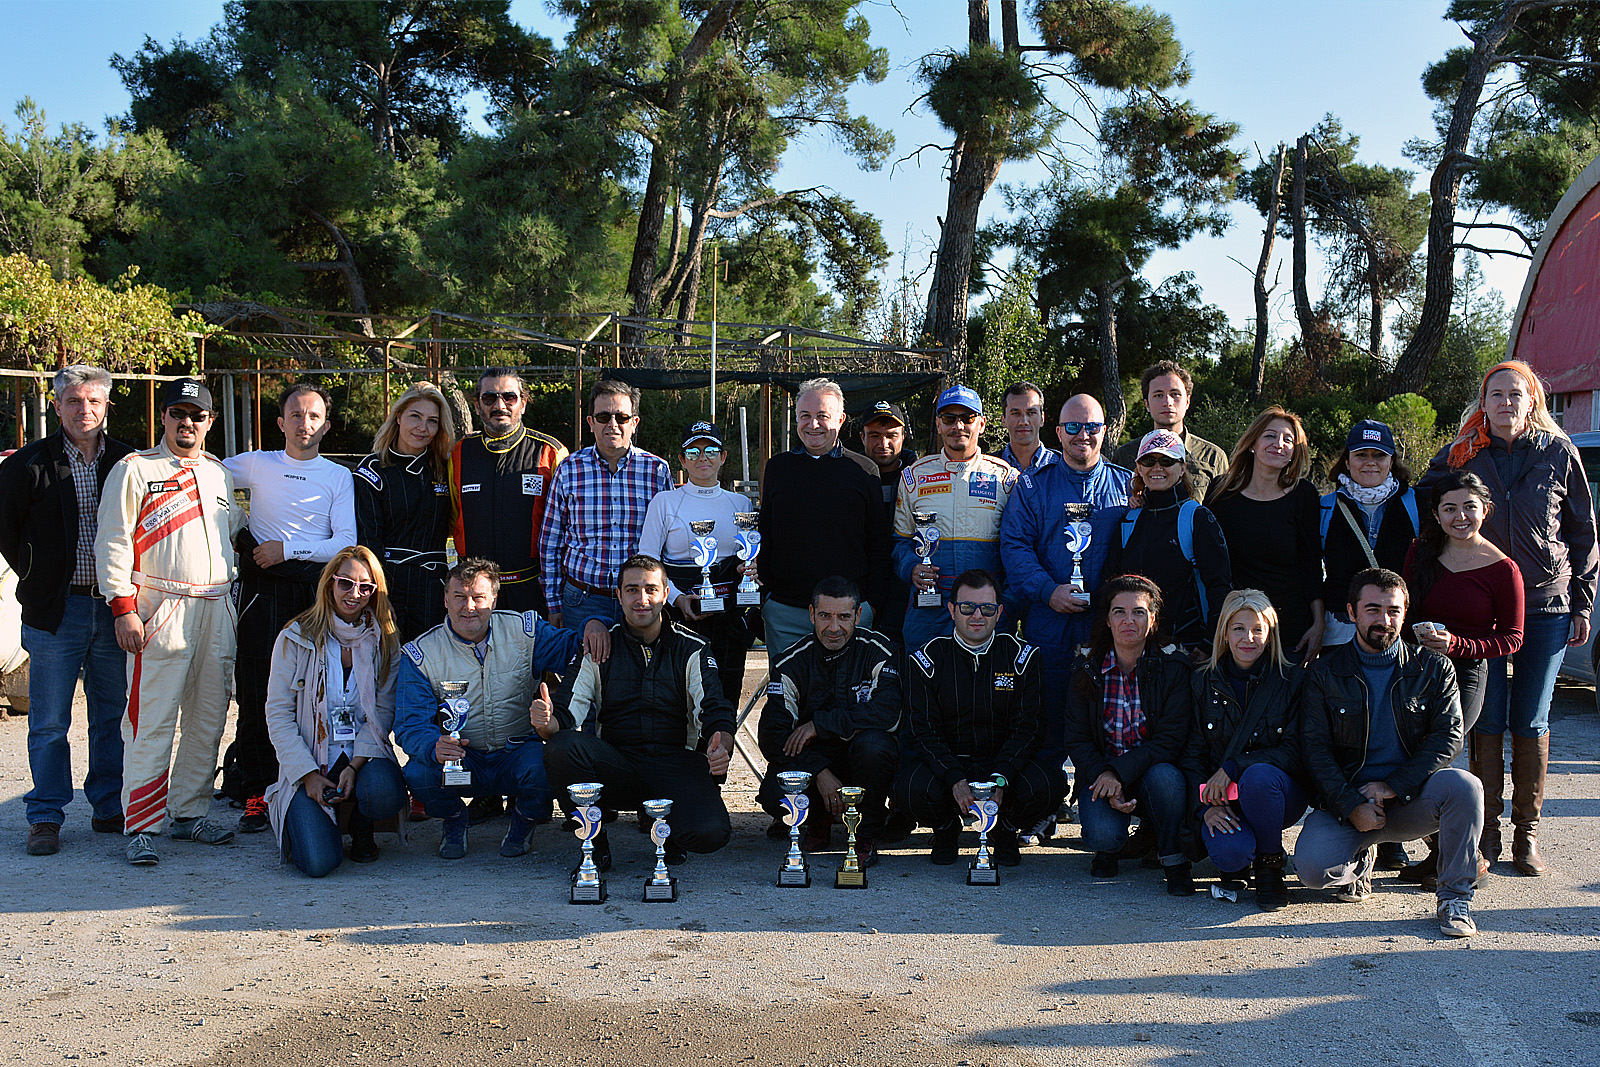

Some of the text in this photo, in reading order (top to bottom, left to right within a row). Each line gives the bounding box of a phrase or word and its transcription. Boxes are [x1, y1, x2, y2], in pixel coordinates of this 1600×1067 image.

[150, 482, 164, 491] GT
[920, 486, 950, 496] PIRELLI
[971, 489, 994, 497] PEUGEOT
